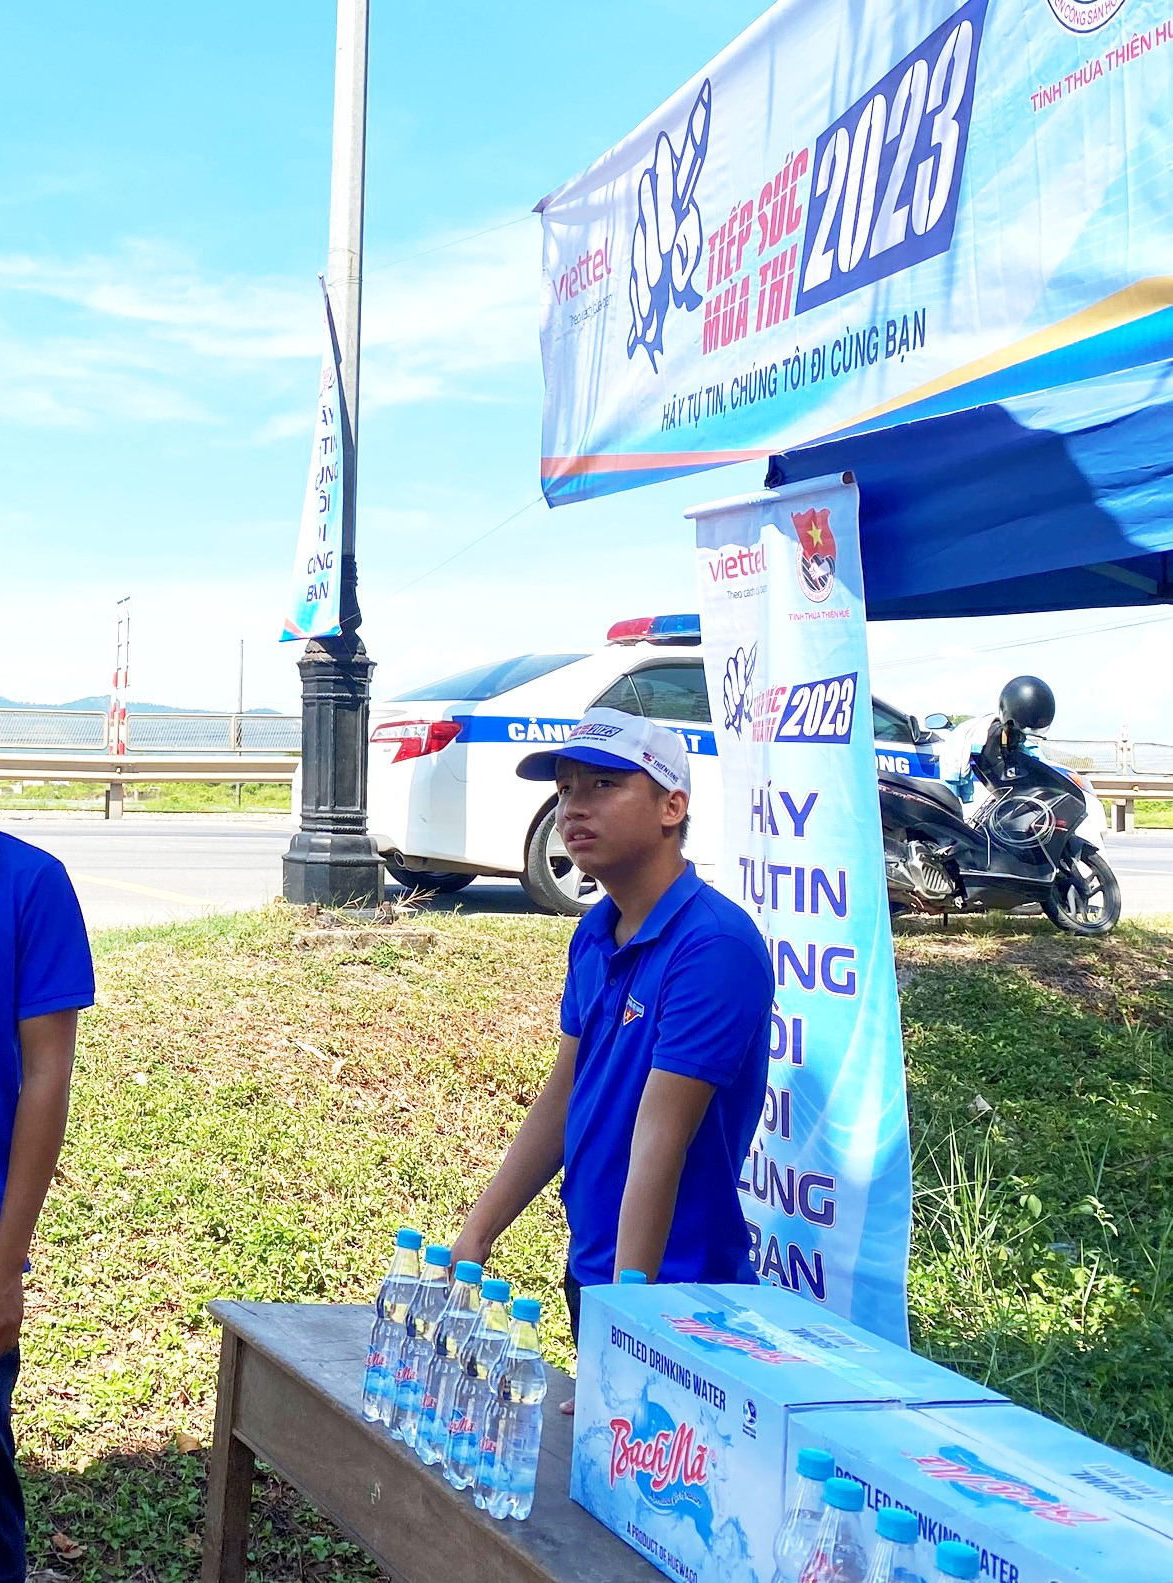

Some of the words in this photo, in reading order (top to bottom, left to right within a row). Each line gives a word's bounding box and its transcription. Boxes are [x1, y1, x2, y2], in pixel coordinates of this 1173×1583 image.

[1030, 85, 1062, 112] TỈNH
[1105, 32, 1152, 72] THIÊN
[802, 19, 974, 294] 2023
[707, 200, 754, 294] TIẾP
[757, 147, 809, 257] SỨC
[702, 275, 751, 356] MÙA
[755, 242, 799, 333] THI
[661, 395, 686, 432] HÃY
[687, 386, 704, 428] TỰ
[705, 382, 727, 418] TIN,
[730, 361, 778, 411] CHÚNG
[782, 345, 807, 393] TÔI
[810, 344, 827, 384] ĐI
[830, 326, 880, 378] CÙNG
[884, 307, 927, 363] BẠN
[587, 724, 621, 737] 2023
[779, 676, 855, 738] 2023
[876, 755, 911, 776] NG
[767, 864, 848, 918] TIN
[769, 934, 856, 996] NG
[611, 1325, 647, 1363] BOTTLED
[648, 1347, 691, 1389] DRINKING
[693, 1373, 726, 1412] WATER
[627, 1520, 632, 1536] A
[632, 1524, 658, 1556] PRODUCT
[966, 1540, 1019, 1583] ATER
